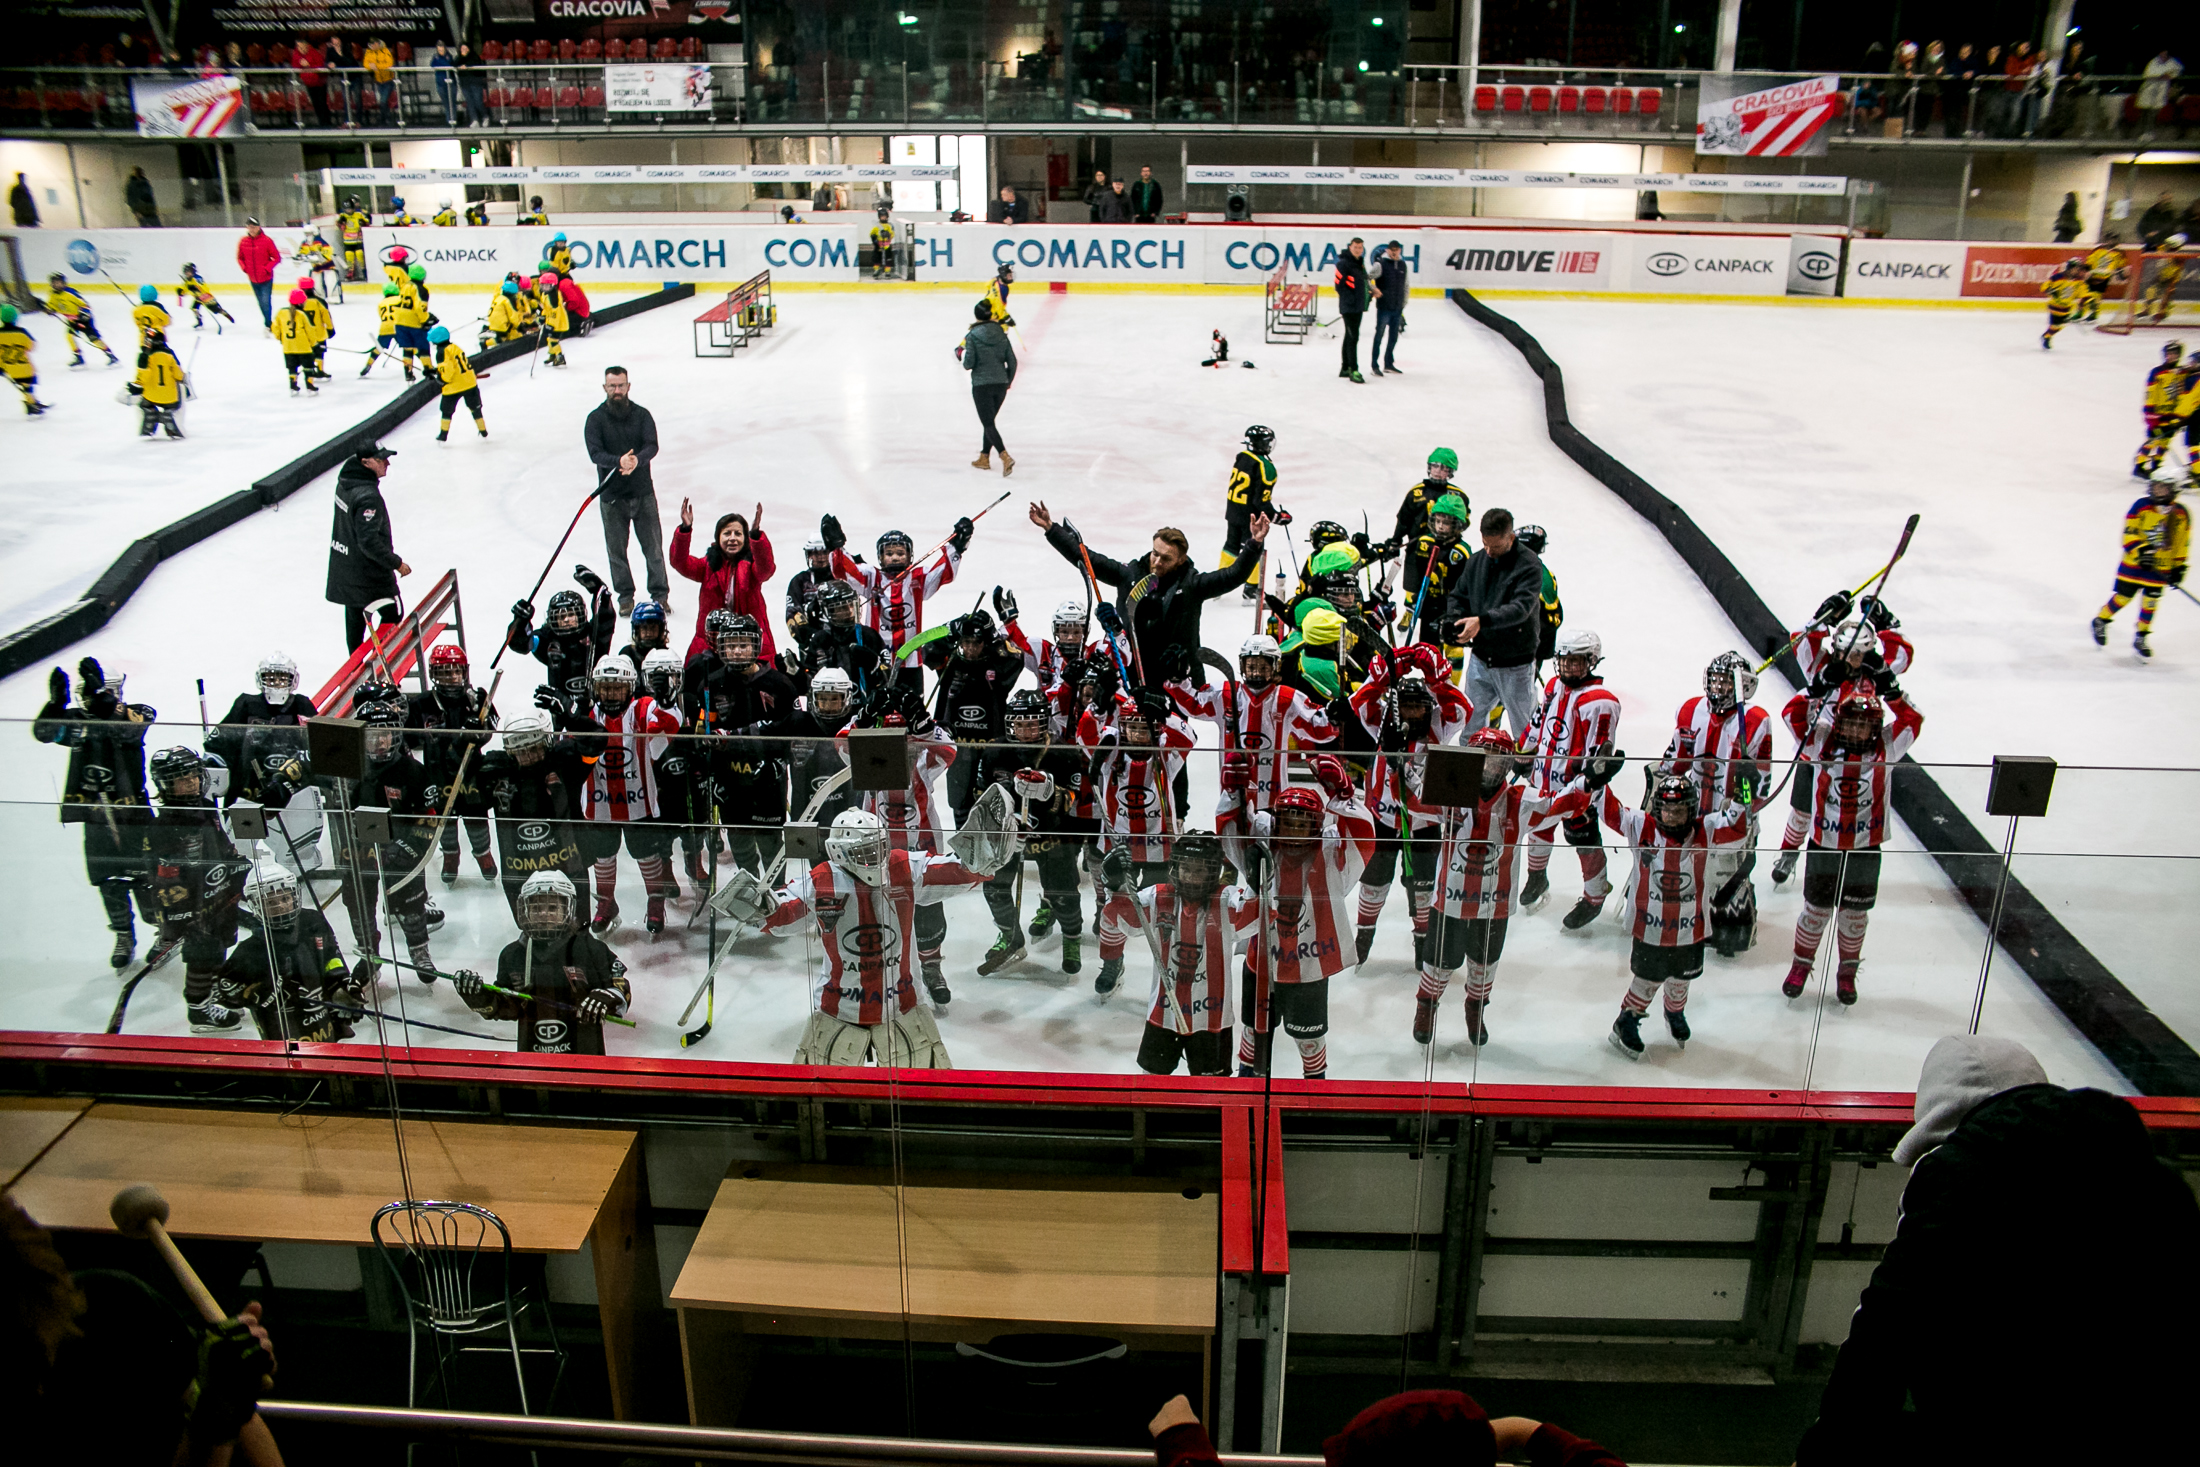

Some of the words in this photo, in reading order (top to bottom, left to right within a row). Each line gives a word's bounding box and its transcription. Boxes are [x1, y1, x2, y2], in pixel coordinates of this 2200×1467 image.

[550, 0, 646, 17] CRACOVIA
[1732, 79, 1825, 114] CRACOVIA
[423, 249, 498, 262] CANPACK
[764, 238, 953, 268] COMCH
[992, 238, 1184, 270] COMARCH
[1445, 248, 1555, 273] 4MOVE
[1694, 258, 1774, 273] CANPACK
[1857, 261, 1952, 280] CANPACK
[286, 320, 296, 340] 3
[157, 364, 165, 387] 1
[954, 721, 988, 730] CANPACK
[1118, 808, 1161, 820] CANPACK
[516, 838, 557, 851] CANPACK
[505, 842, 580, 871] COMARCH
[1287, 1023, 1324, 1033] BAUER
